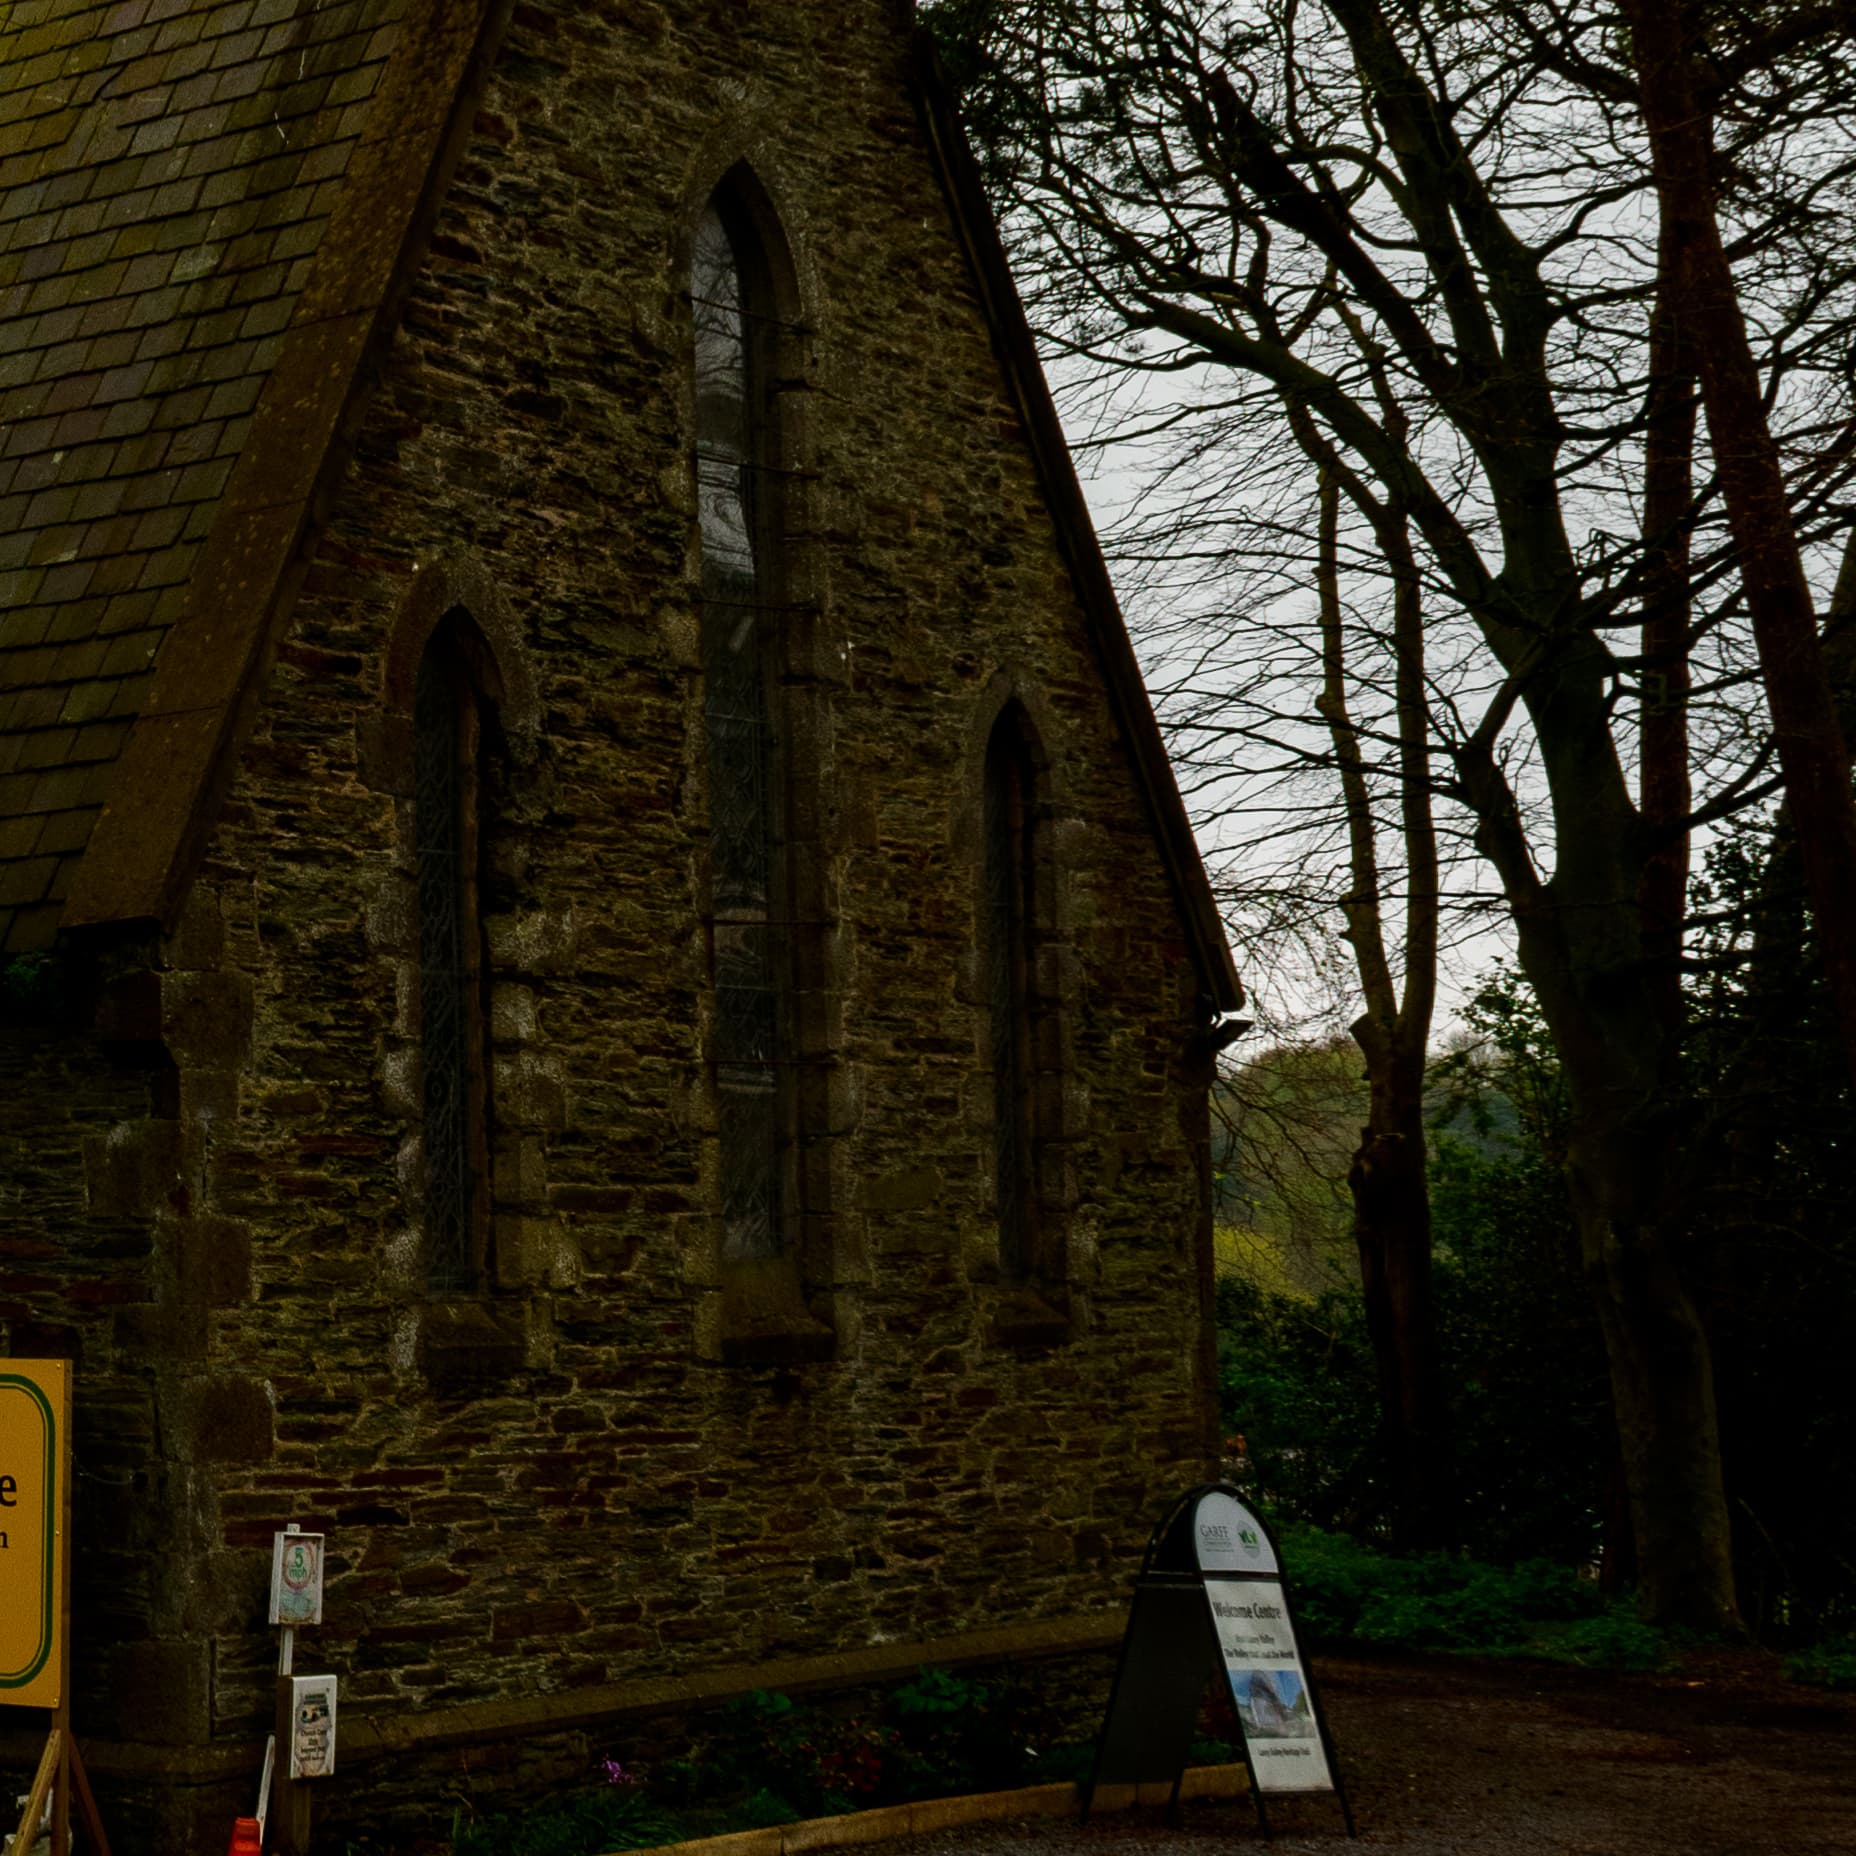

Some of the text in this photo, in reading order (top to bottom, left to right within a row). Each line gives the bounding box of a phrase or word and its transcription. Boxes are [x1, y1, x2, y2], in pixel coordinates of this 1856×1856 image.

[295, 1546, 304, 1568] 5
[1213, 1601, 1281, 1619] Welcome Centre
